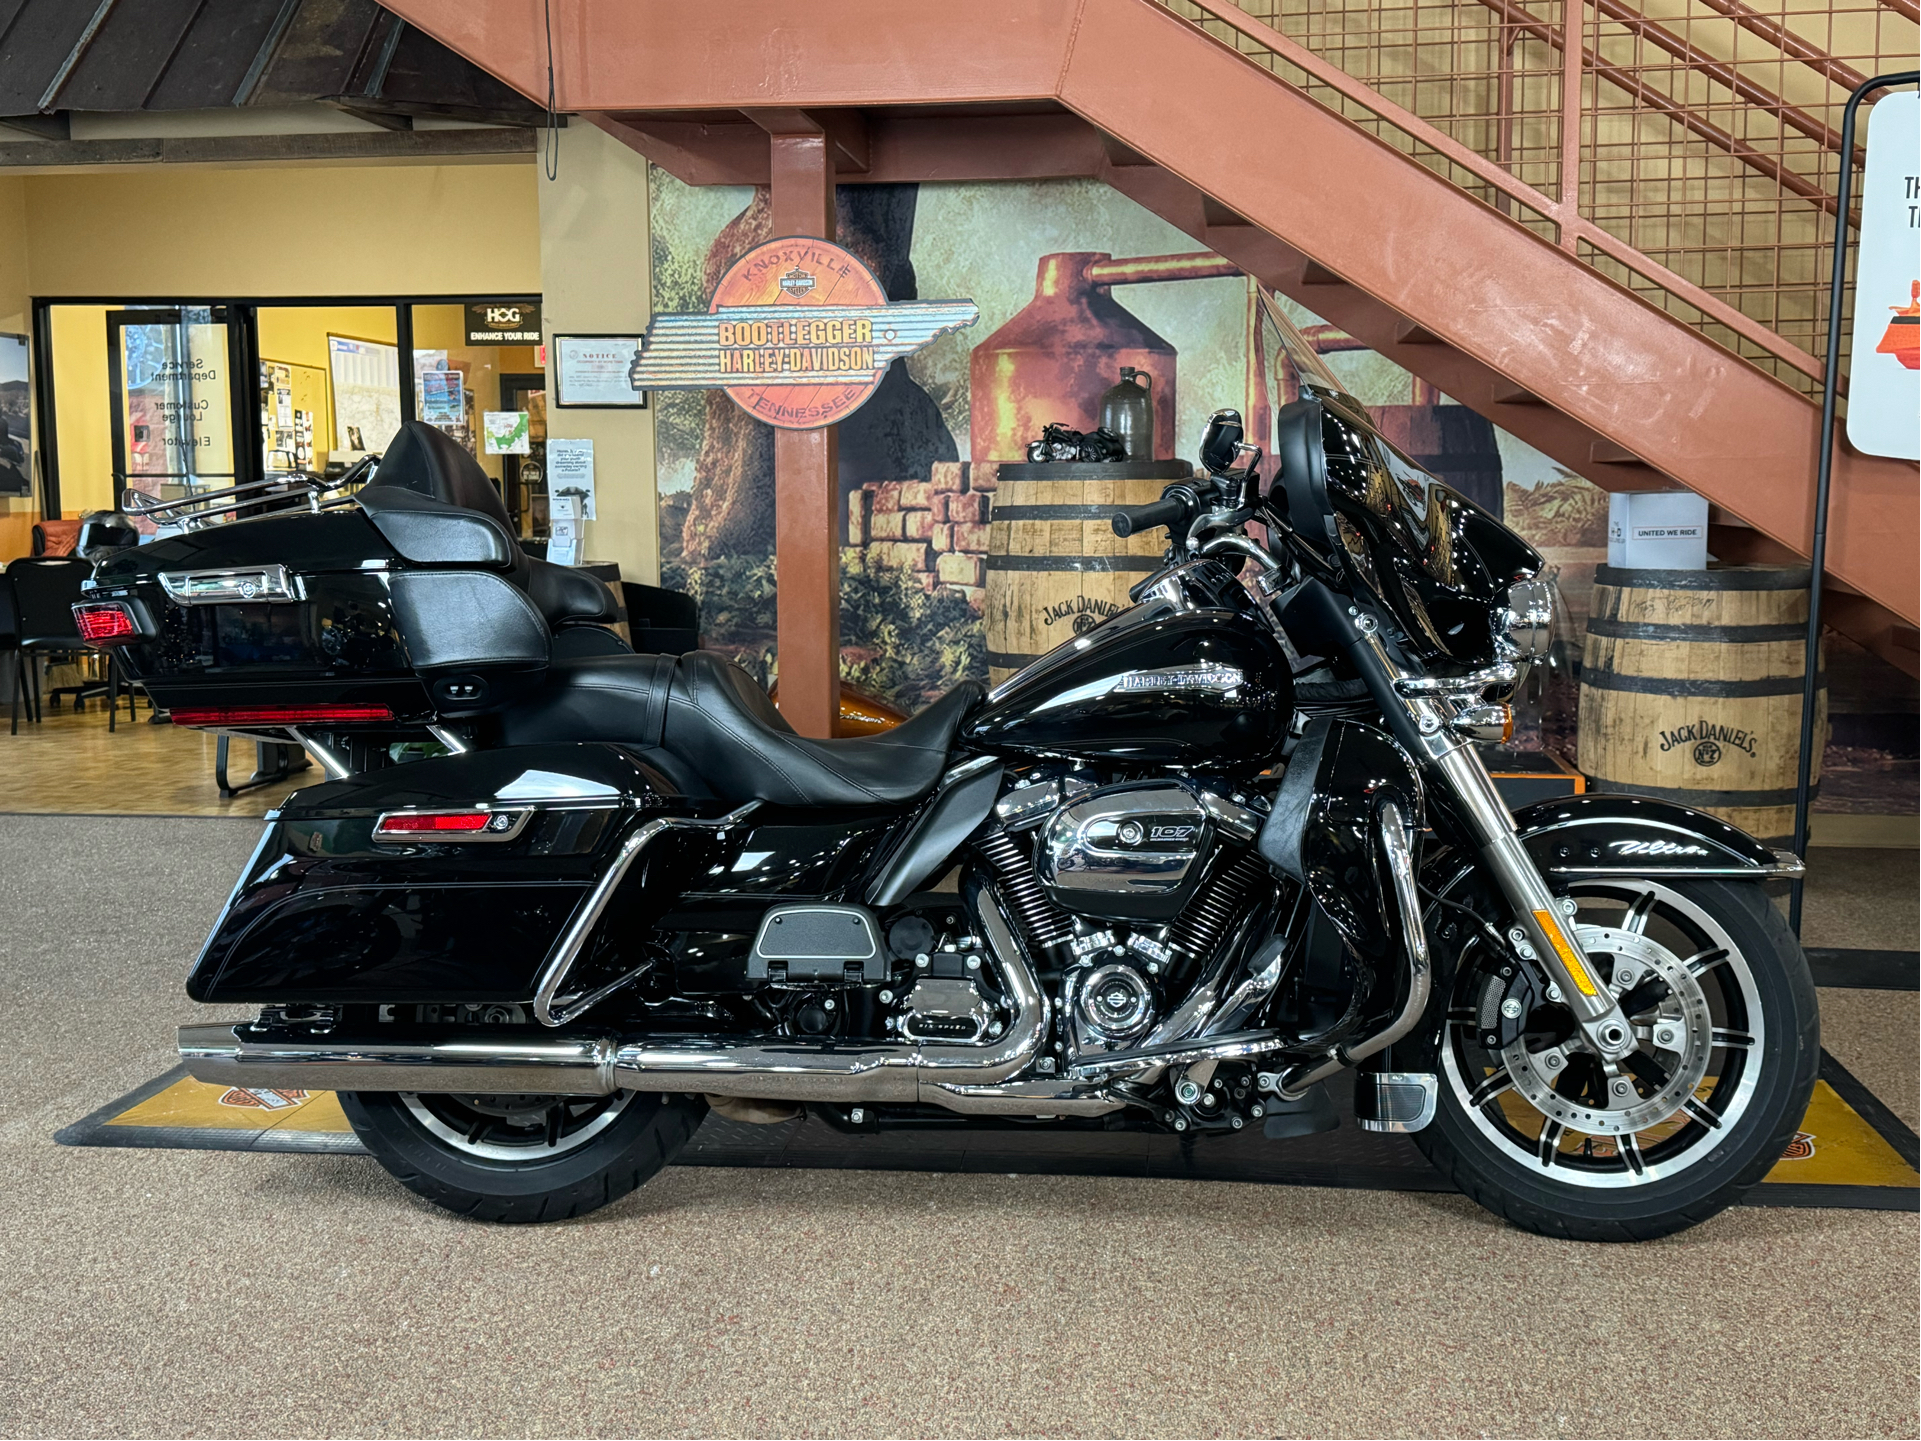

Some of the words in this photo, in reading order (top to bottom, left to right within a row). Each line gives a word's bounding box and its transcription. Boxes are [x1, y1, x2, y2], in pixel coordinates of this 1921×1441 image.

[742, 249, 851, 282] KNOXVILLE
[486, 308, 520, 323] HOG
[470, 332, 503, 341] ENHANCE
[504, 332, 523, 341] YOUR
[523, 332, 540, 341] RIDE
[718, 319, 873, 346] BOOTLEGGER
[718, 347, 875, 373] HARLEY-DAVIDSON
[746, 387, 857, 419] TENNESSEE
[1666, 529, 1679, 537] WE
[1043, 598, 1075, 626] JACK
[1659, 724, 1697, 751] JACK
[1699, 720, 1757, 753] DANIEL'S
[1150, 826, 1194, 837] 107
[1608, 839, 1709, 857] Ultra
